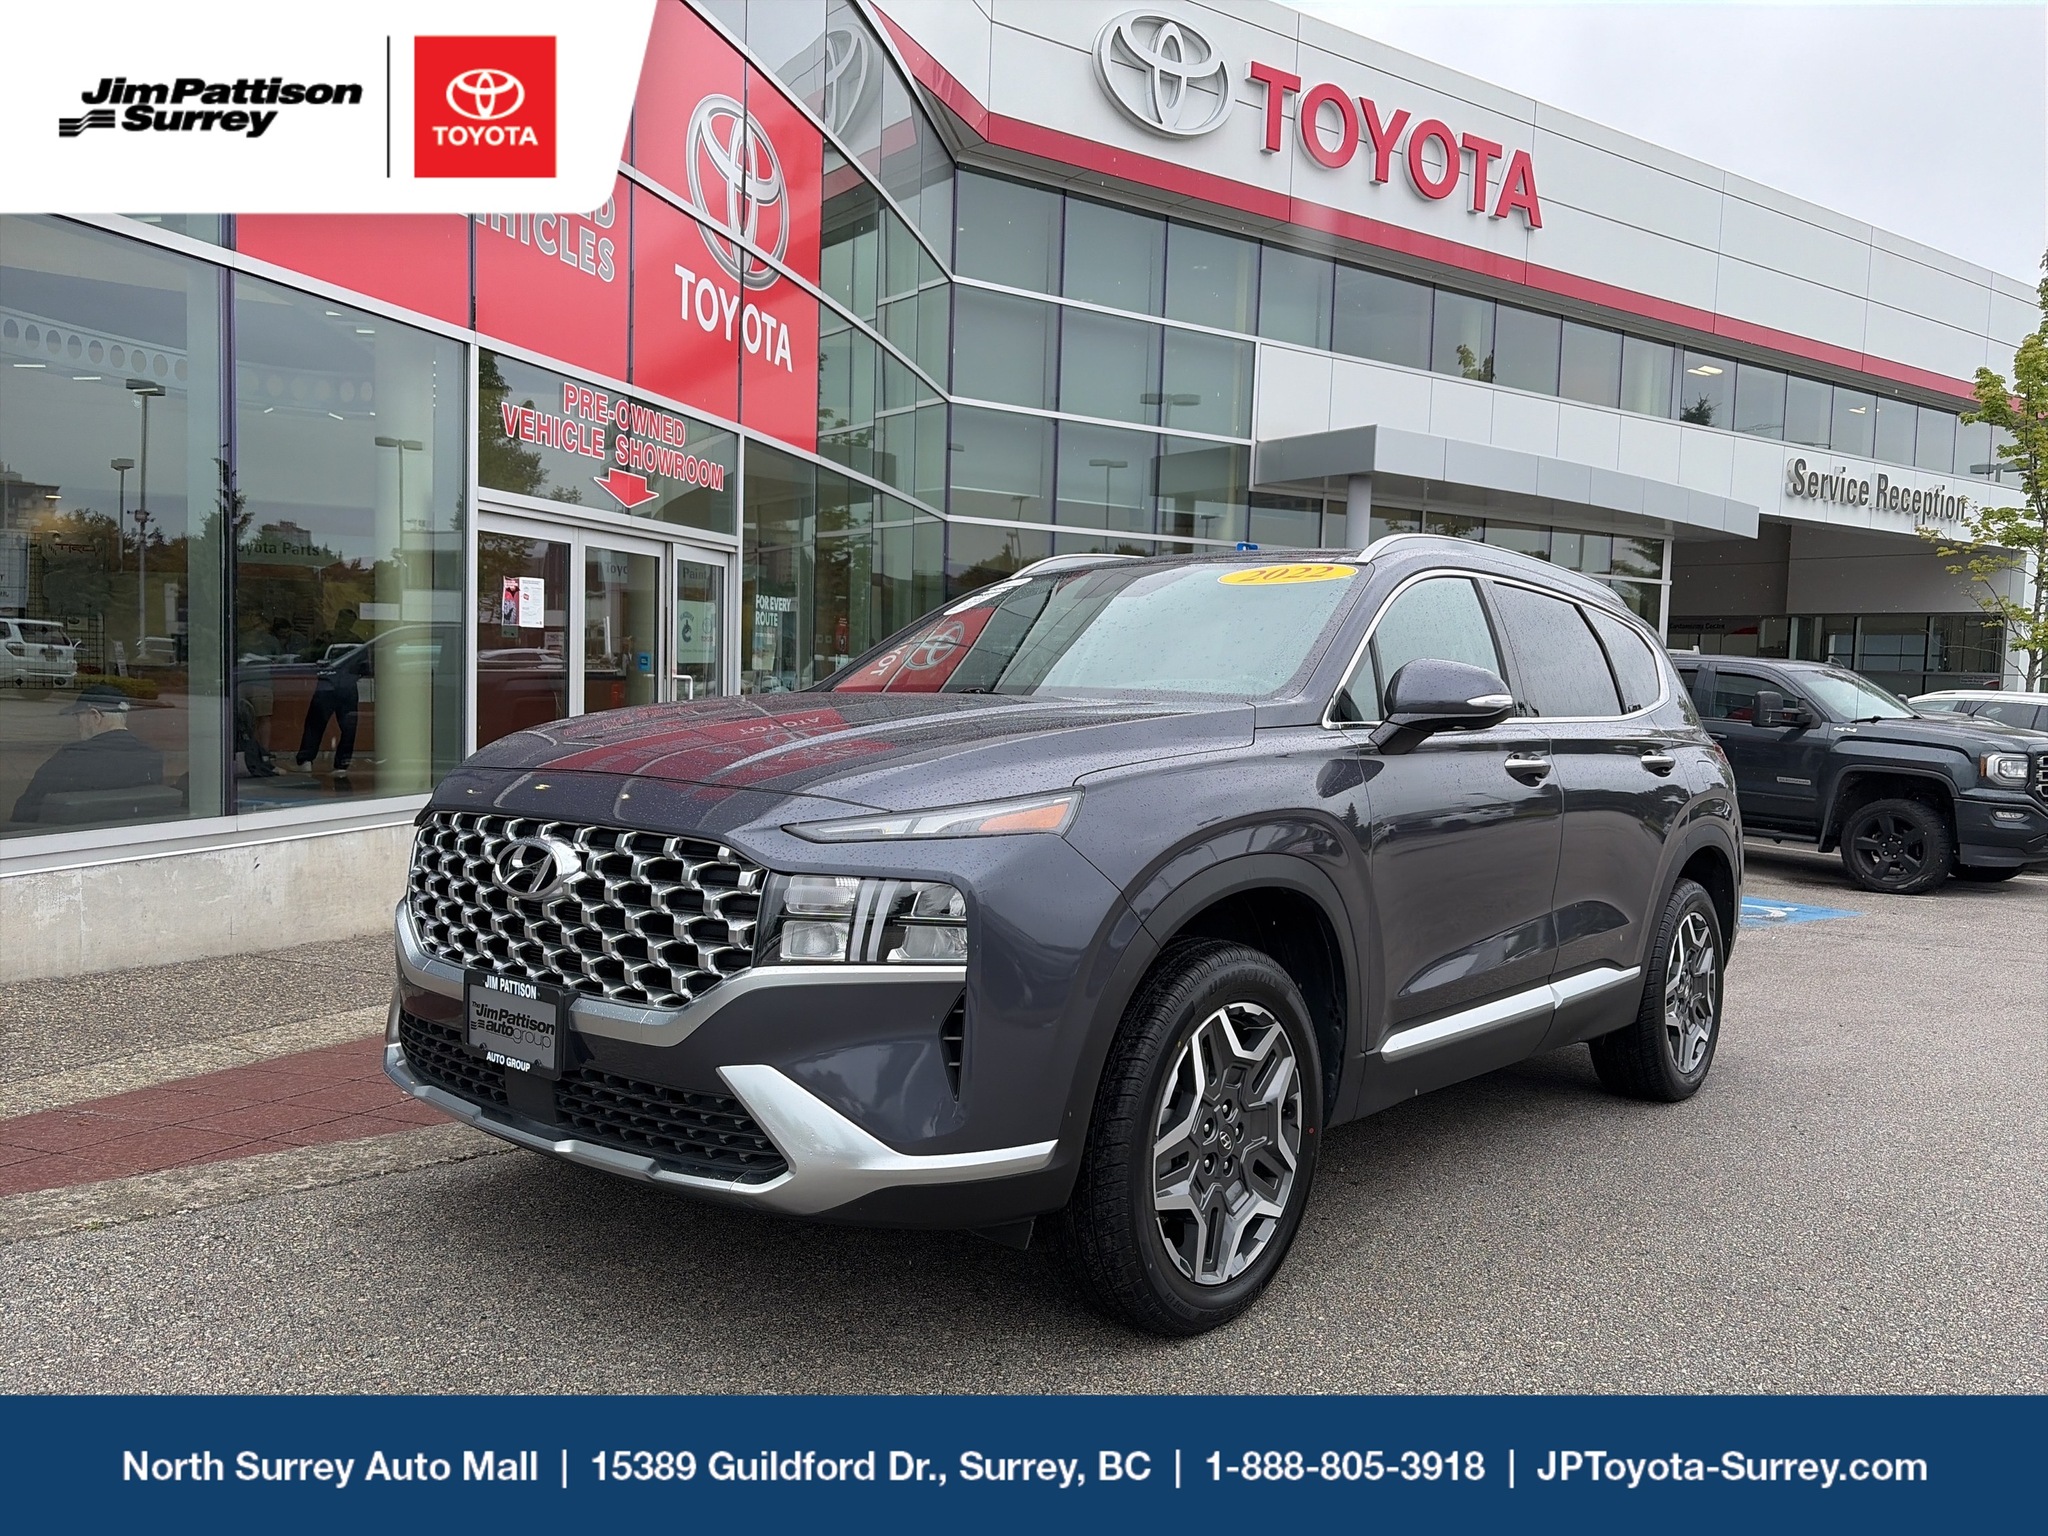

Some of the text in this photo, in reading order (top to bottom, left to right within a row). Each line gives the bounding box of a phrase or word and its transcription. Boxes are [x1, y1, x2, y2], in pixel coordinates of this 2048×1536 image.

[1245, 60, 1543, 230] TOYOTA
[675, 263, 793, 373] TOYOTA
[563, 382, 686, 448] PRE-OWNED
[501, 401, 724, 492] VEHICLE SHOWROOM
[1787, 458, 1965, 525] Service Reception
[237, 542, 320, 556] oyota Parts
[1237, 566, 1334, 583] 2022
[755, 594, 792, 612] FOR EVERY
[755, 611, 779, 627] ROUTE
[485, 975, 537, 999] JIM PATTISON
[486, 1051, 531, 1072] AUTO GROUP
